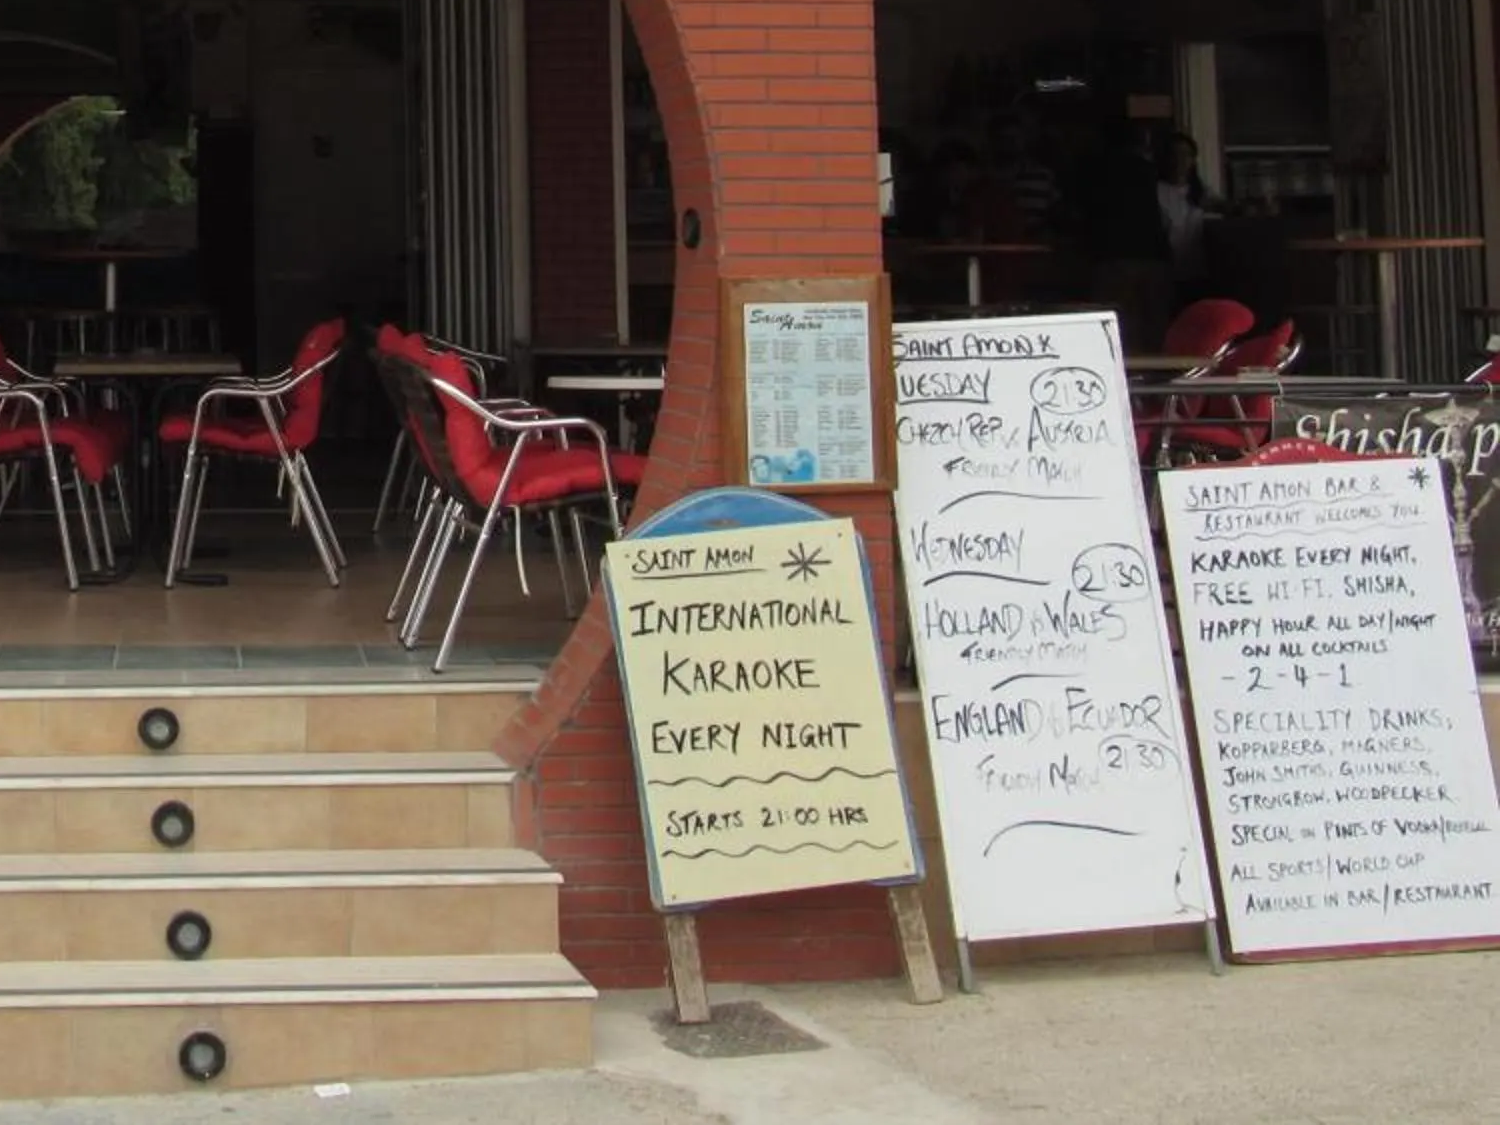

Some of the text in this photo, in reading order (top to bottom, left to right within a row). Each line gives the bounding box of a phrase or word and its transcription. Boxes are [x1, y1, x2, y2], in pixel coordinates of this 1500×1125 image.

[893, 333, 954, 358] SAINT
[895, 366, 991, 399] UESDAY
[1186, 482, 1253, 508] SAINT
[1259, 476, 1312, 499] AMON
[1325, 476, 1358, 496] BAR
[1204, 509, 1302, 533] RESTAURANT
[631, 545, 755, 574] SAINT AMON
[1190, 547, 1287, 574] KARAOKE
[1295, 546, 1351, 568] EVERY
[1193, 581, 1253, 606] FREE
[629, 598, 853, 638] INTERNATIONAL
[1200, 617, 1262, 642] HAPPY
[1271, 615, 1319, 635] HOUR
[1327, 614, 1352, 632] ALL
[1241, 642, 1270, 660] ON
[1278, 641, 1302, 658] ALL
[662, 650, 820, 696] KARAOKE
[932, 694, 1043, 743] ENGLAND
[1213, 707, 1352, 734] SPECIALITY
[651, 720, 863, 756] EVERY NIGHT
[1222, 765, 1267, 788] JOHN
[666, 809, 744, 838] STARTS
[829, 806, 869, 826] HRS
[1232, 823, 1294, 847] SPECIAL
[1371, 819, 1388, 836] OF
[1230, 863, 1256, 883] ALL
